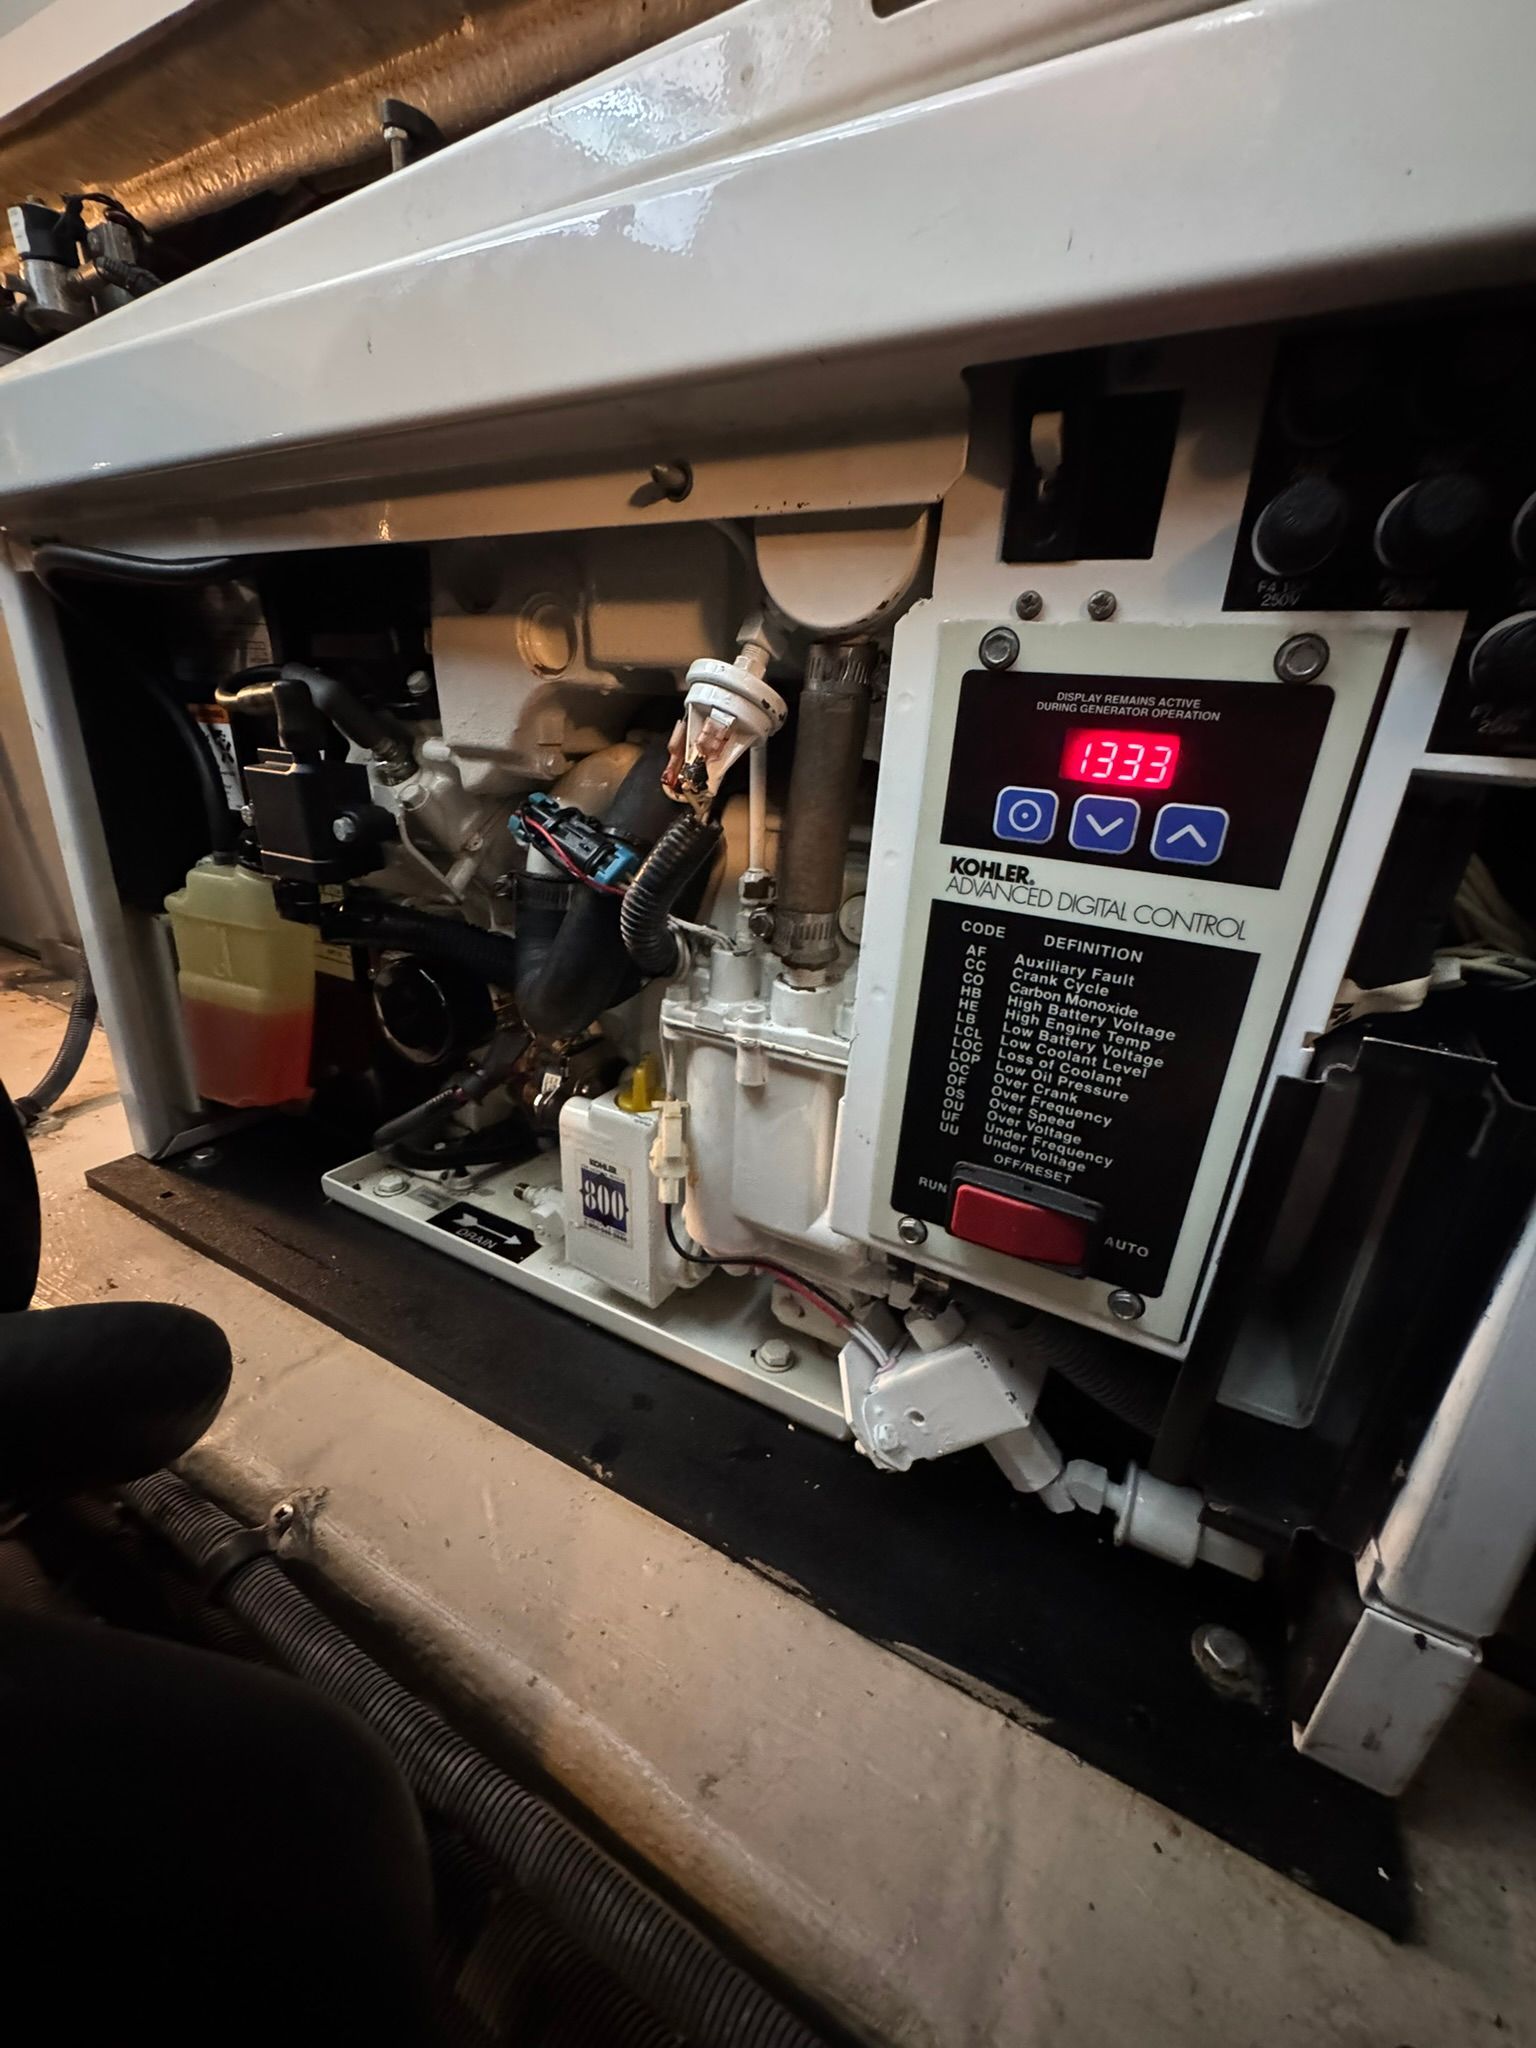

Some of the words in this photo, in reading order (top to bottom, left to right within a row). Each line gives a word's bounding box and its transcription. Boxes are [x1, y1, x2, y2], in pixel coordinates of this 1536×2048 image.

[1036, 701, 1077, 713] DURING
[1080, 704, 1149, 718] GENERATOR
[1152, 708, 1221, 721] OPERATION
[1057, 692, 1101, 703] DISPLAY
[1104, 694, 1155, 707] REMAINS
[1158, 697, 1201, 709] ACTIVE
[1080, 741, 1172, 783] 1333
[945, 875, 1053, 909] ADVANCED
[1057, 891, 1127, 922] DIGITAL
[1133, 904, 1246, 940] CONTROL
[961, 920, 1006, 938] CODE
[966, 944, 987, 957] AF
[1043, 934, 1143, 963] DEFINITION
[964, 958, 986, 972] CC
[1014, 953, 1086, 980] Auxiliary
[1091, 967, 1135, 987] Fault
[962, 972, 984, 986] CO
[1012, 967, 1059, 987] Crank
[1063, 977, 1110, 997] Cycle
[960, 985, 982, 998] HB
[1009, 981, 1061, 1003] Carbon
[1065, 993, 1139, 1019] Monoxide
[958, 998, 980, 1012] HE
[957, 1011, 976, 1024] LB
[1007, 995, 1042, 1013] High
[1047, 1003, 1106, 1028] Battery
[1112, 1019, 1177, 1041] Voltage
[954, 1023, 983, 1040] LCL
[1004, 1009, 1040, 1027] High
[1045, 1017, 1101, 1040] Engine
[1106, 1030, 1151, 1051] Temp
[952, 1036, 984, 1052] LOC
[1002, 1021, 1034, 1038] Low
[1038, 1030, 1097, 1054] Battery
[1102, 1043, 1164, 1068] Voltage
[950, 1049, 981, 1064] LOP
[998, 1047, 1034, 1065] Loss
[1038, 1058, 1055, 1070] of
[1059, 1062, 1122, 1087] Coolant
[1000, 1035, 1031, 1050] Low
[1036, 1044, 1098, 1067] Coolant
[1102, 1058, 1148, 1078] Level
[948, 1061, 970, 1076] OC
[947, 1074, 967, 1087] OF
[993, 1072, 1029, 1091] Over
[1033, 1083, 1078, 1104] Crank
[995, 1060, 1027, 1077] Low
[1031, 1068, 1052, 1084] Oil
[1057, 1075, 1129, 1103] Pressure
[945, 1086, 966, 1099] OS
[941, 1109, 960, 1122] UF
[943, 1098, 964, 1112] OU
[989, 1098, 1024, 1116] Over
[1027, 1107, 1076, 1130] Speed
[991, 1085, 1027, 1103] Over
[1030, 1096, 1113, 1128] Frequency
[939, 1121, 959, 1136] UU
[986, 1110, 1021, 1127] Over
[1026, 1120, 1082, 1145] Voltage
[983, 1134, 1026, 1155] Under
[1031, 1147, 1086, 1173] Voltage
[984, 1122, 1028, 1142] Under
[1032, 1135, 1114, 1168] Frequency
[589, 1158, 617, 1175] KOHLER
[993, 1153, 1072, 1184] OFF/RESET
[918, 1176, 947, 1193] RUN
[584, 1179, 625, 1222] 800
[455, 1227, 499, 1249] DRAIN
[1104, 1236, 1149, 1258] AUTO
